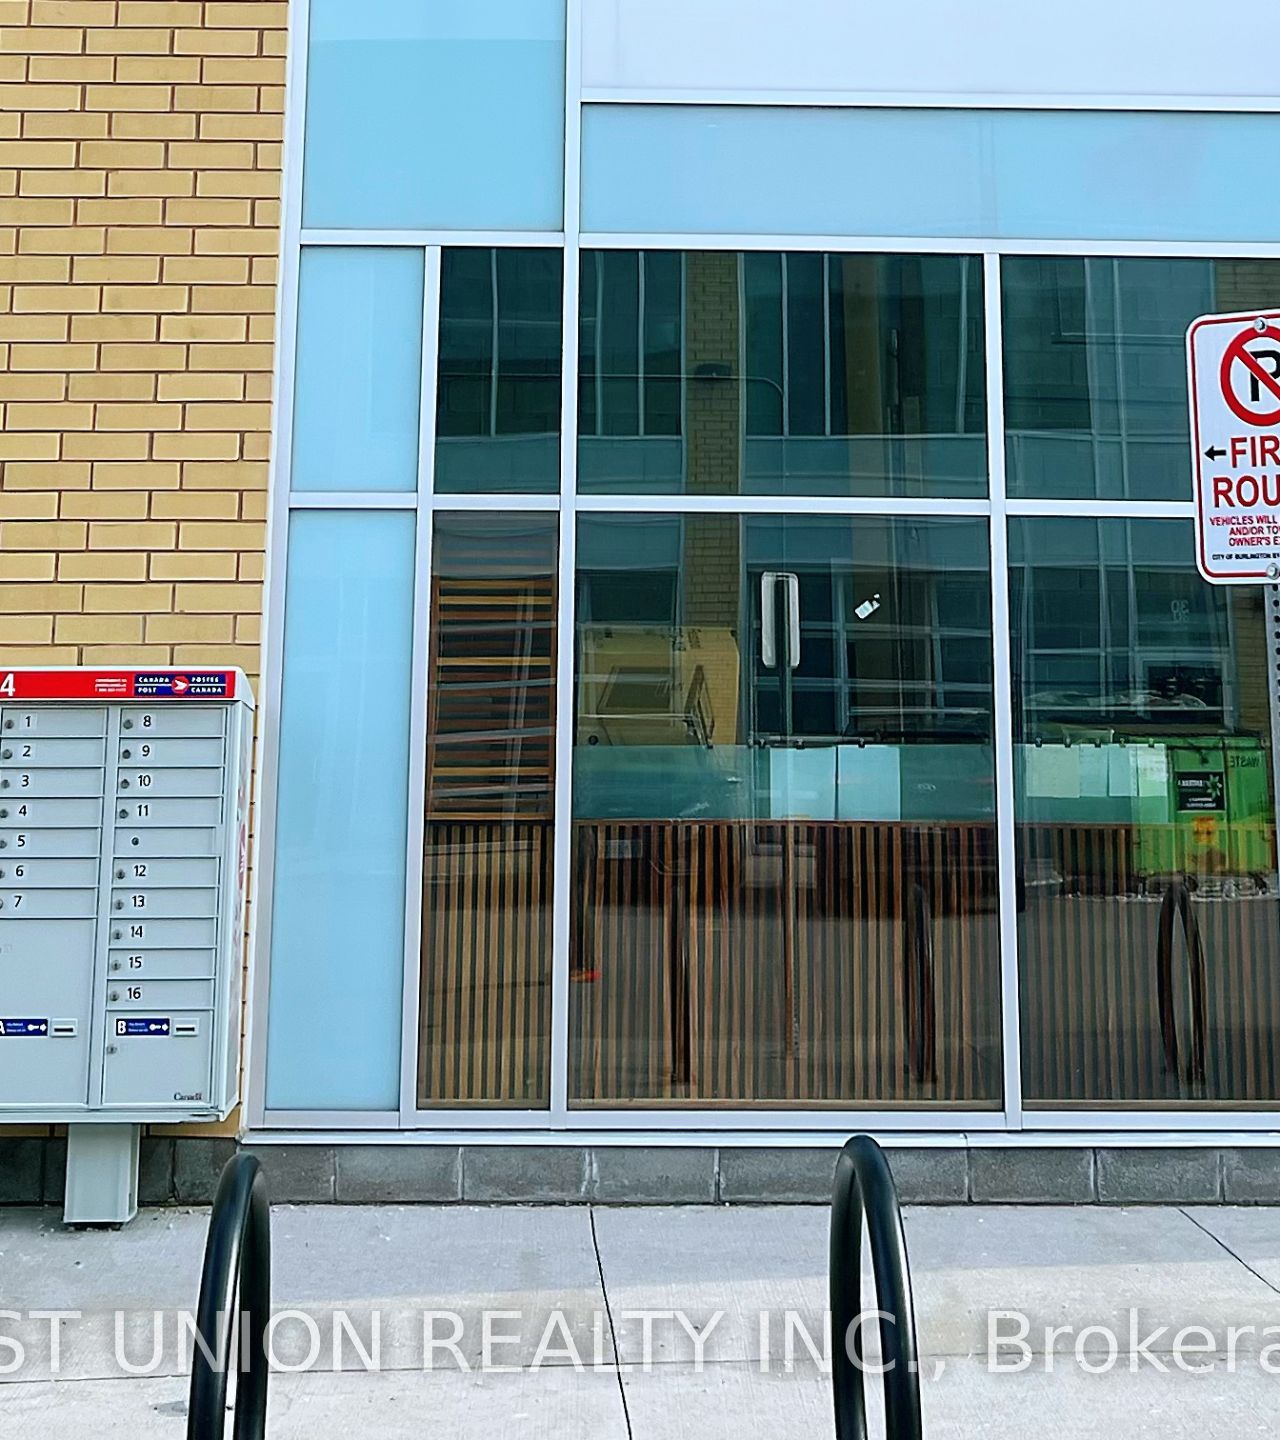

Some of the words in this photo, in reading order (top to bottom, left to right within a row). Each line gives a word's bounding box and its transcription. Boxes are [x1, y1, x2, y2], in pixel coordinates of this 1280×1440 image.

[1210, 516, 1254, 526] VEHICLES
[1256, 515, 1277, 524] WILL
[1229, 526, 1264, 535] AND/OR
[1228, 537, 1271, 546] OWNER'S
[0, 673, 16, 697] 4
[143, 715, 152, 728] 8
[22, 745, 31, 757] 2
[142, 744, 151, 757] 9
[21, 774, 30, 788] 3
[137, 774, 152, 787] 10
[18, 804, 27, 817] 4
[137, 804, 149, 817] 11
[17, 834, 26, 848] 5
[15, 864, 24, 877] 6
[133, 864, 147, 877] 12
[14, 895, 23, 908] 7
[131, 894, 145, 908] 13
[130, 925, 143, 938] 14
[129, 955, 143, 969] 15
[127, 986, 142, 1000] 16
[117, 1020, 127, 1034] B
